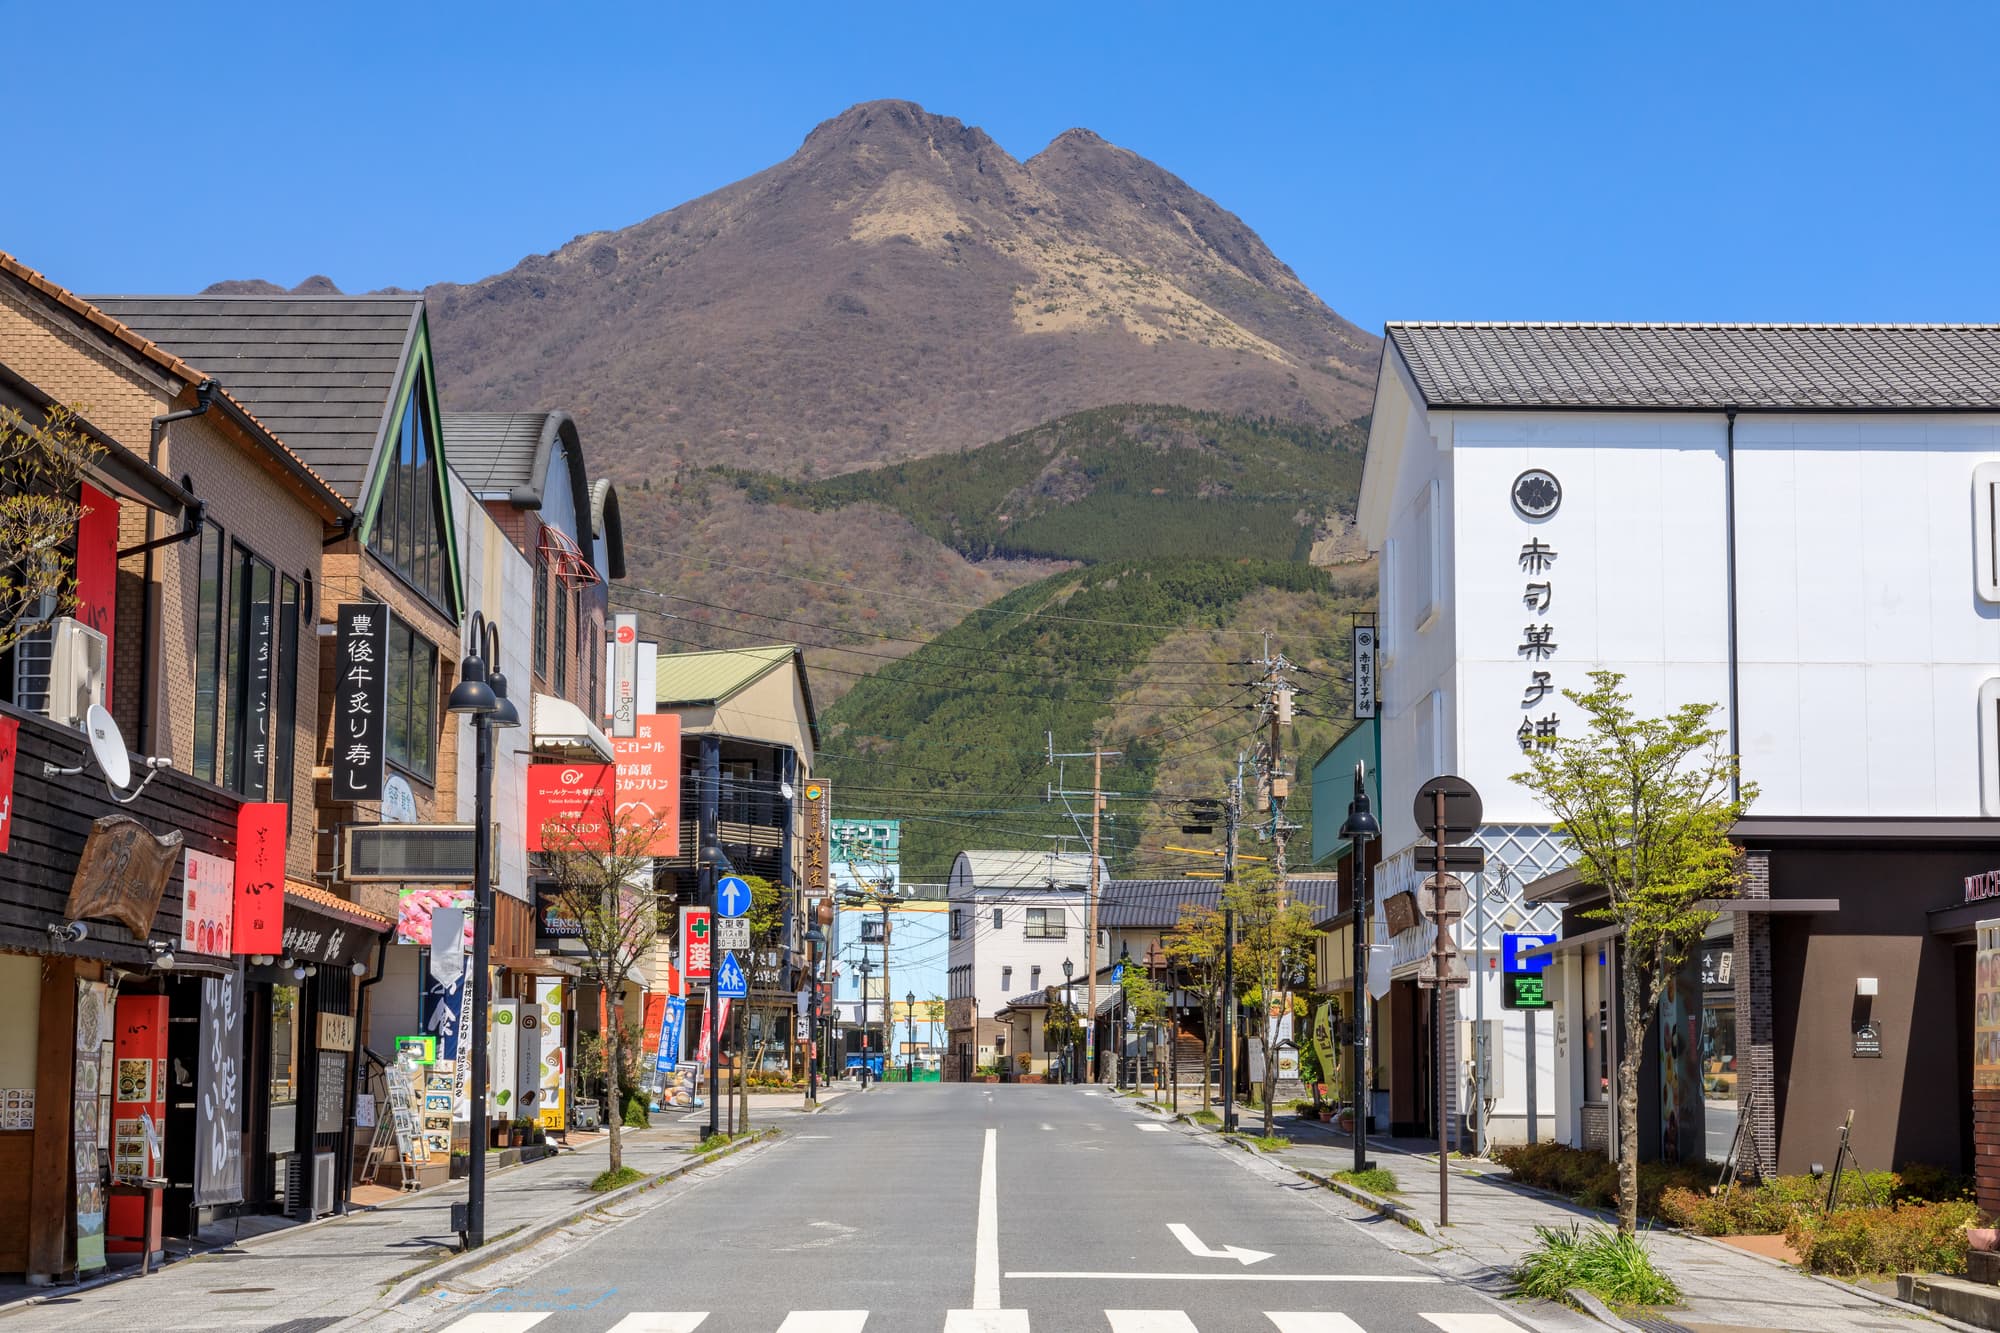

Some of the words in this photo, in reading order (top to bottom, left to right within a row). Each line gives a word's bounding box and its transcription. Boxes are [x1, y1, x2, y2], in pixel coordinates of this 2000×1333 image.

[1518, 537, 1560, 753] 赤司菓子舗
[346, 614, 375, 790] 豊後牛炙り寿し
[690, 943, 710, 971] 薬
[1517, 937, 1544, 970] P
[1515, 978, 1545, 1005] 空
